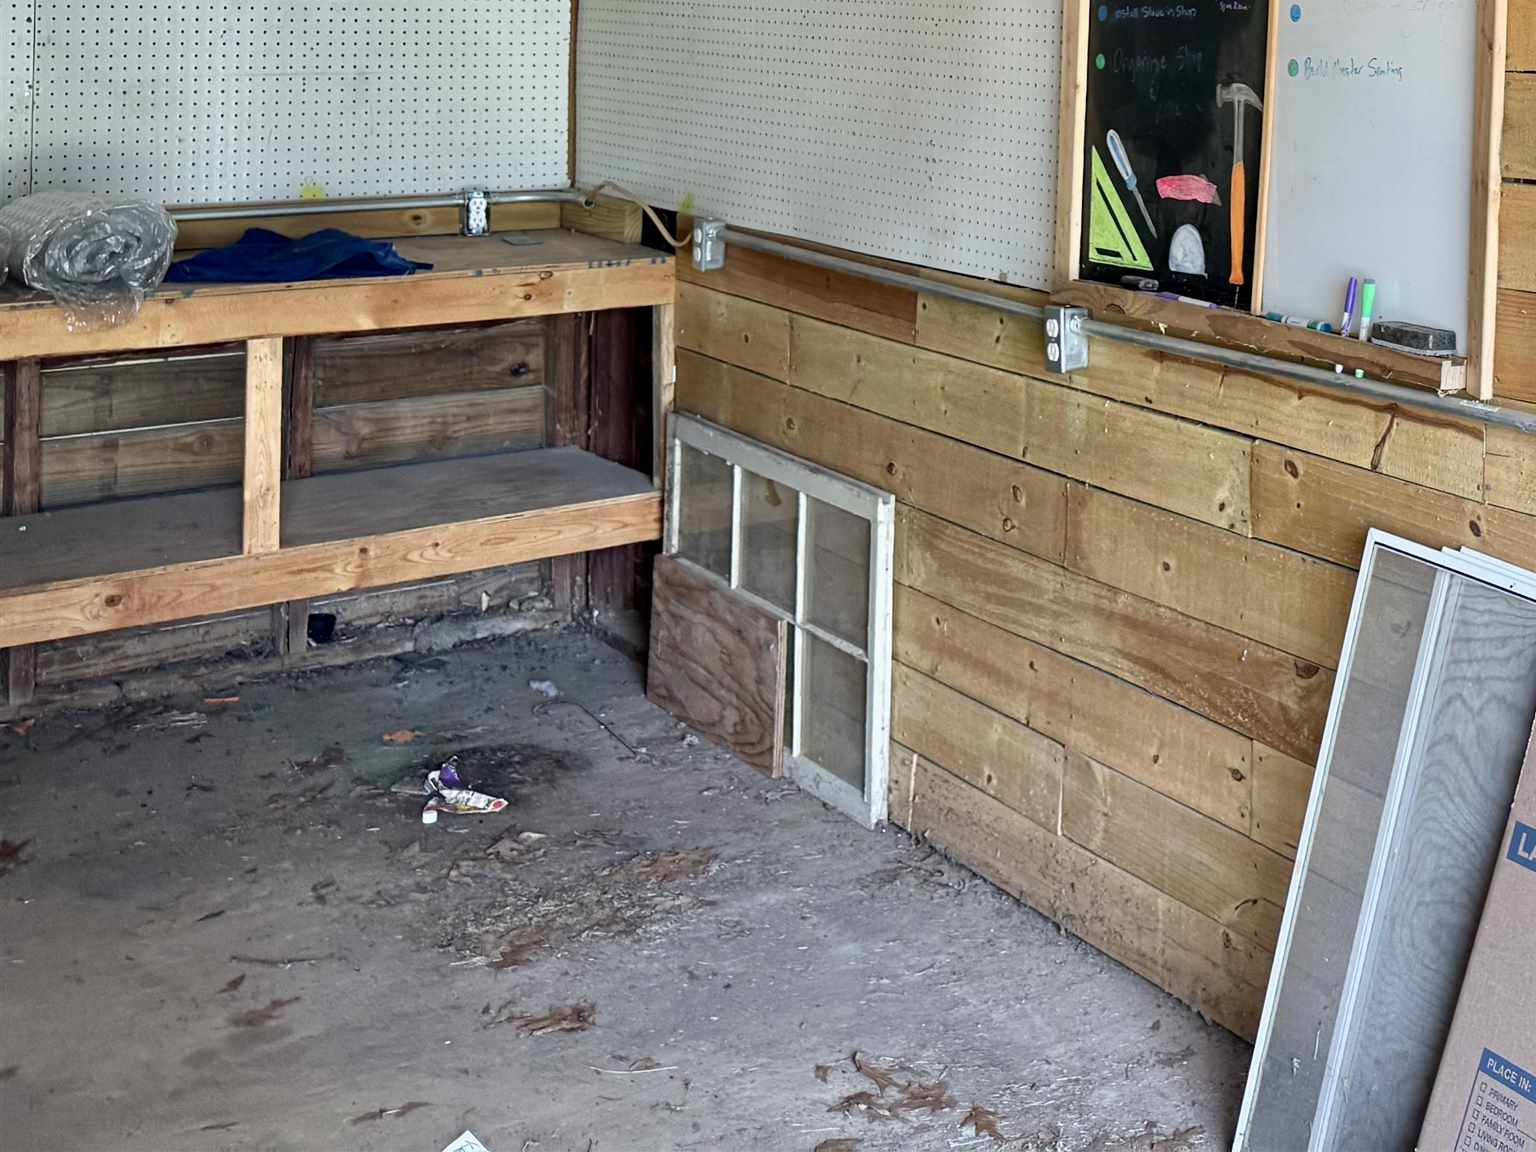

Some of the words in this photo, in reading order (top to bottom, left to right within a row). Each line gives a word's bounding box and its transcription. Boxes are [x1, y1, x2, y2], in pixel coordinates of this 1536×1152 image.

[1486, 1058, 1517, 1085] PLACE
[1518, 1076, 1532, 1093] IN:
[1488, 1088, 1518, 1111] PRIMARY
[1485, 1101, 1519, 1127] BEDROOM
[1478, 1128, 1499, 1147] LIVING
[1481, 1114, 1504, 1135] FAMILY
[1503, 1129, 1526, 1148] ROOM
